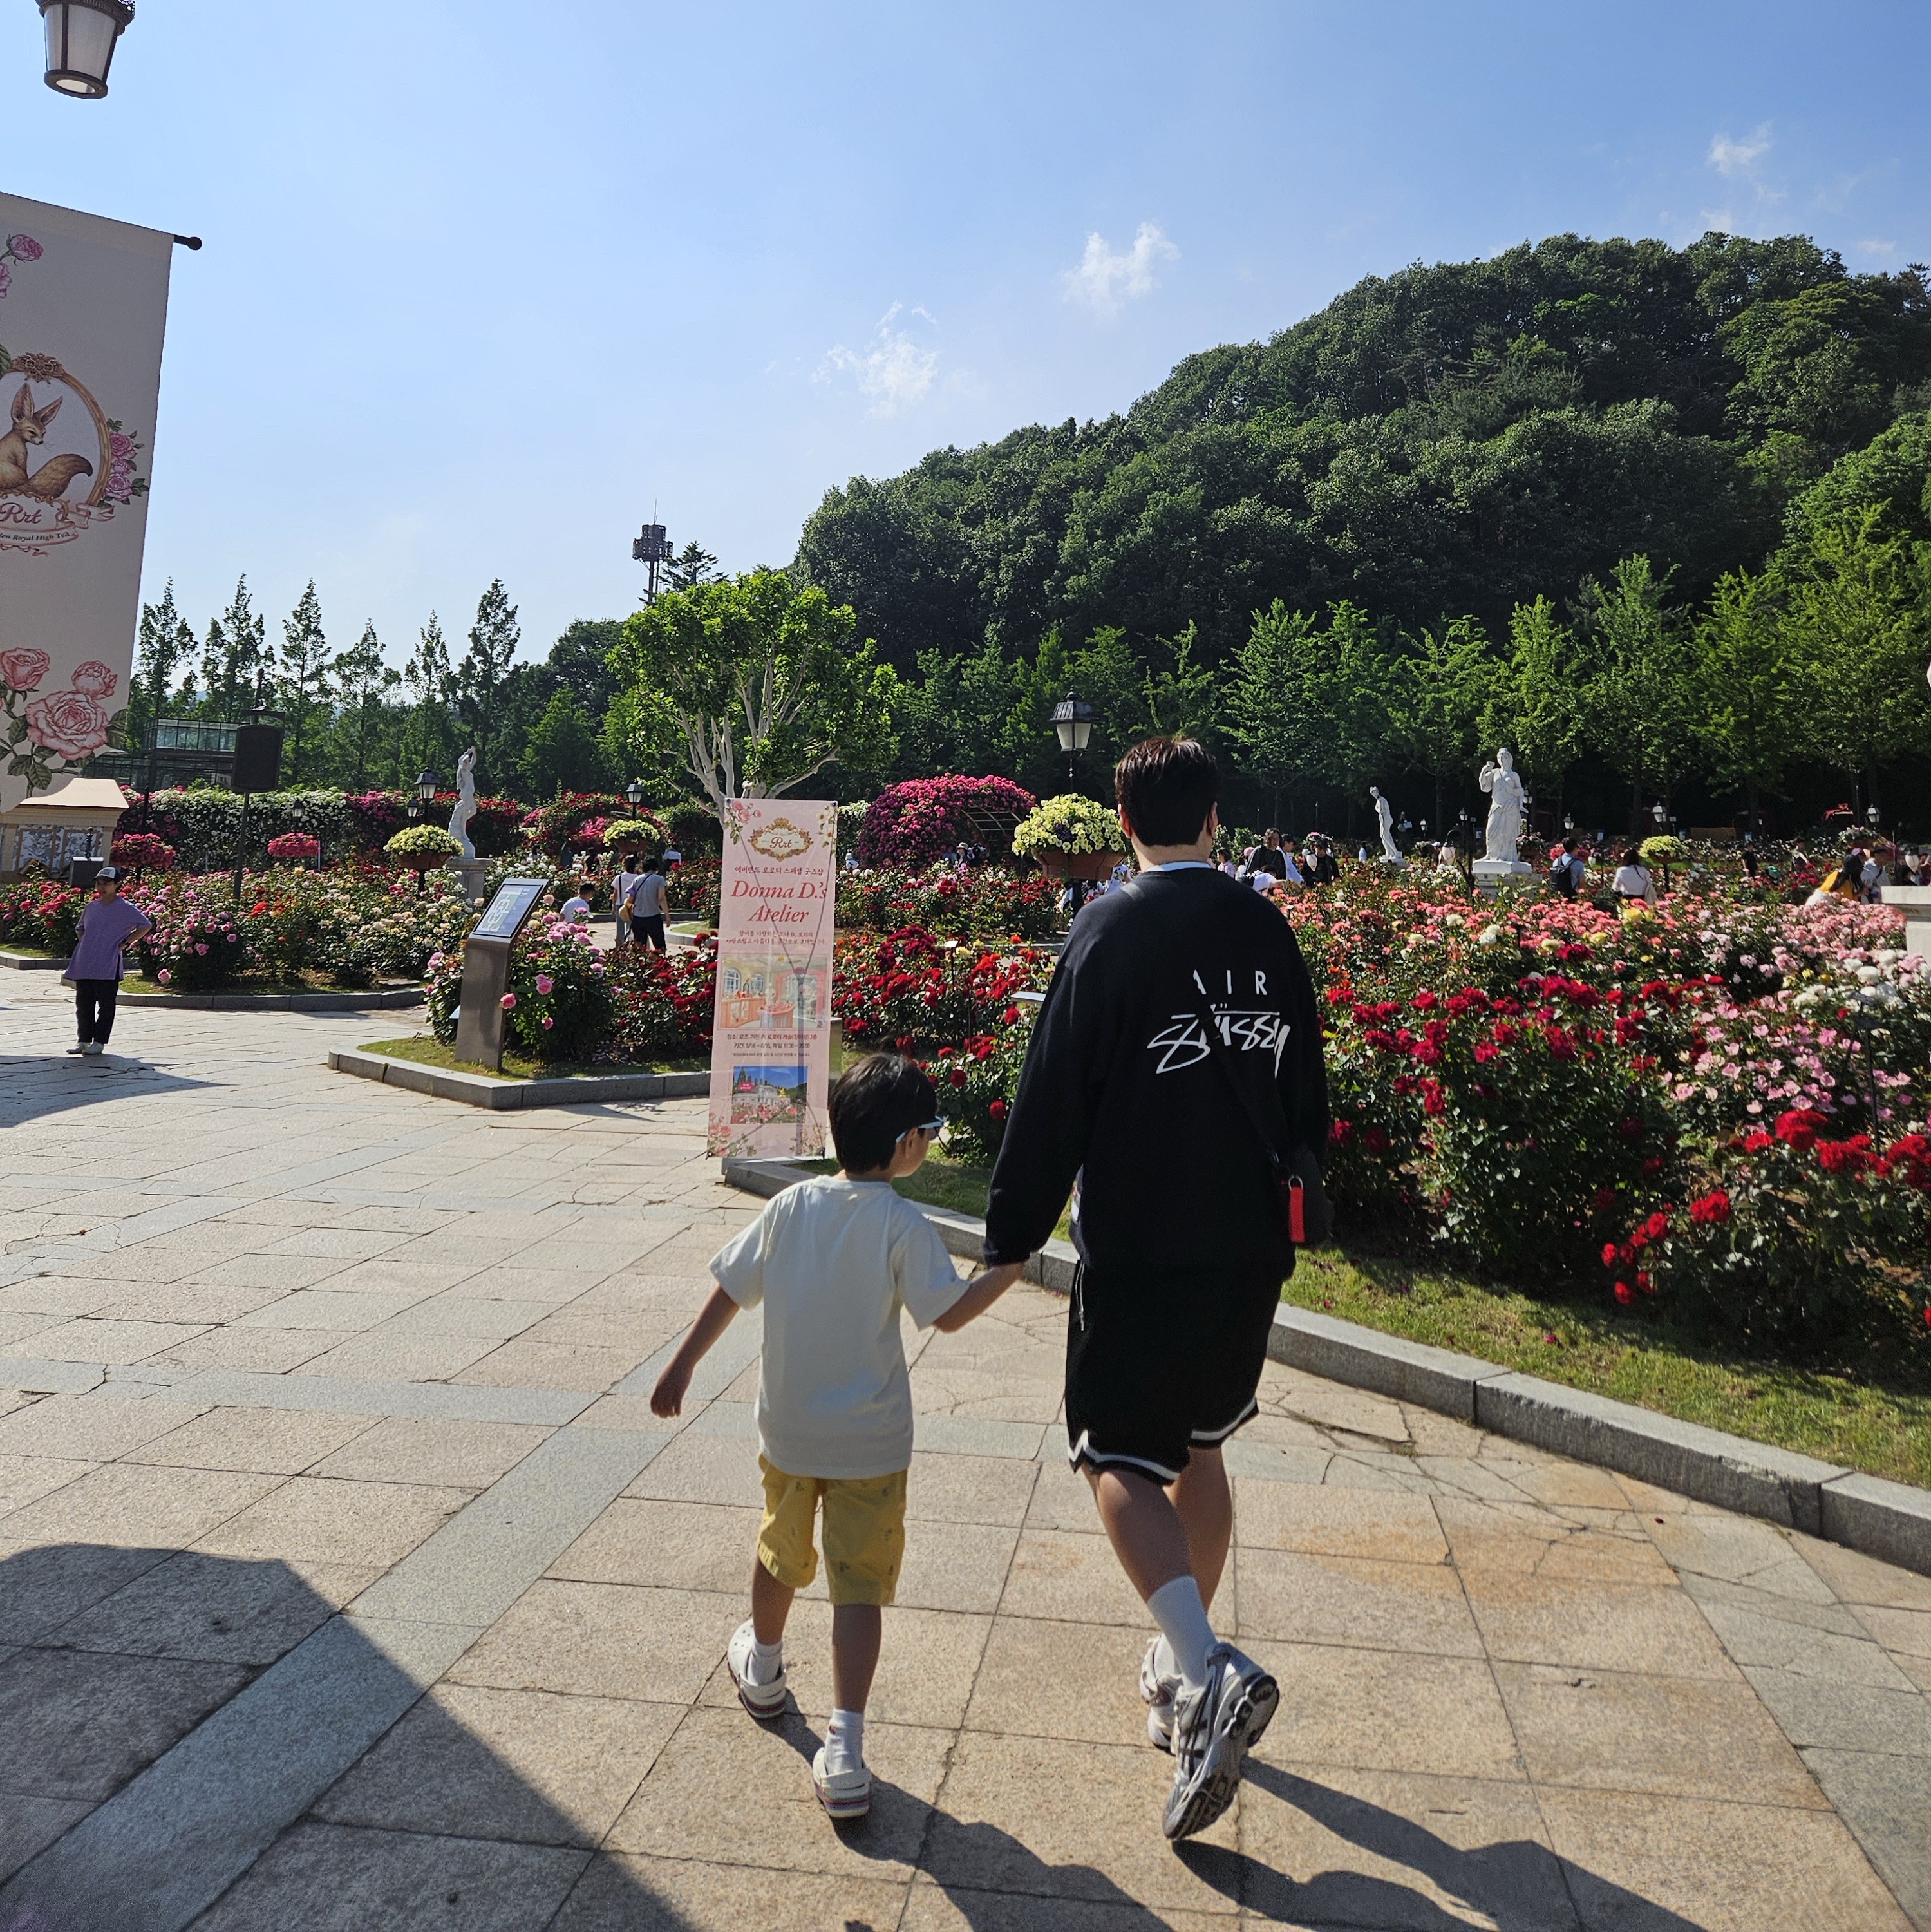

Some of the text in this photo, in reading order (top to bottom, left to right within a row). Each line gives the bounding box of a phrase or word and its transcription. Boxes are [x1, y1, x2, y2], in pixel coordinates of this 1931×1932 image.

[735, 866, 760, 874] 에버랜드
[784, 867, 802, 875] 스페셜
[805, 867, 824, 876] 굿즈샵
[730, 880, 793, 898] Donna
[747, 904, 809, 923] Atelier
